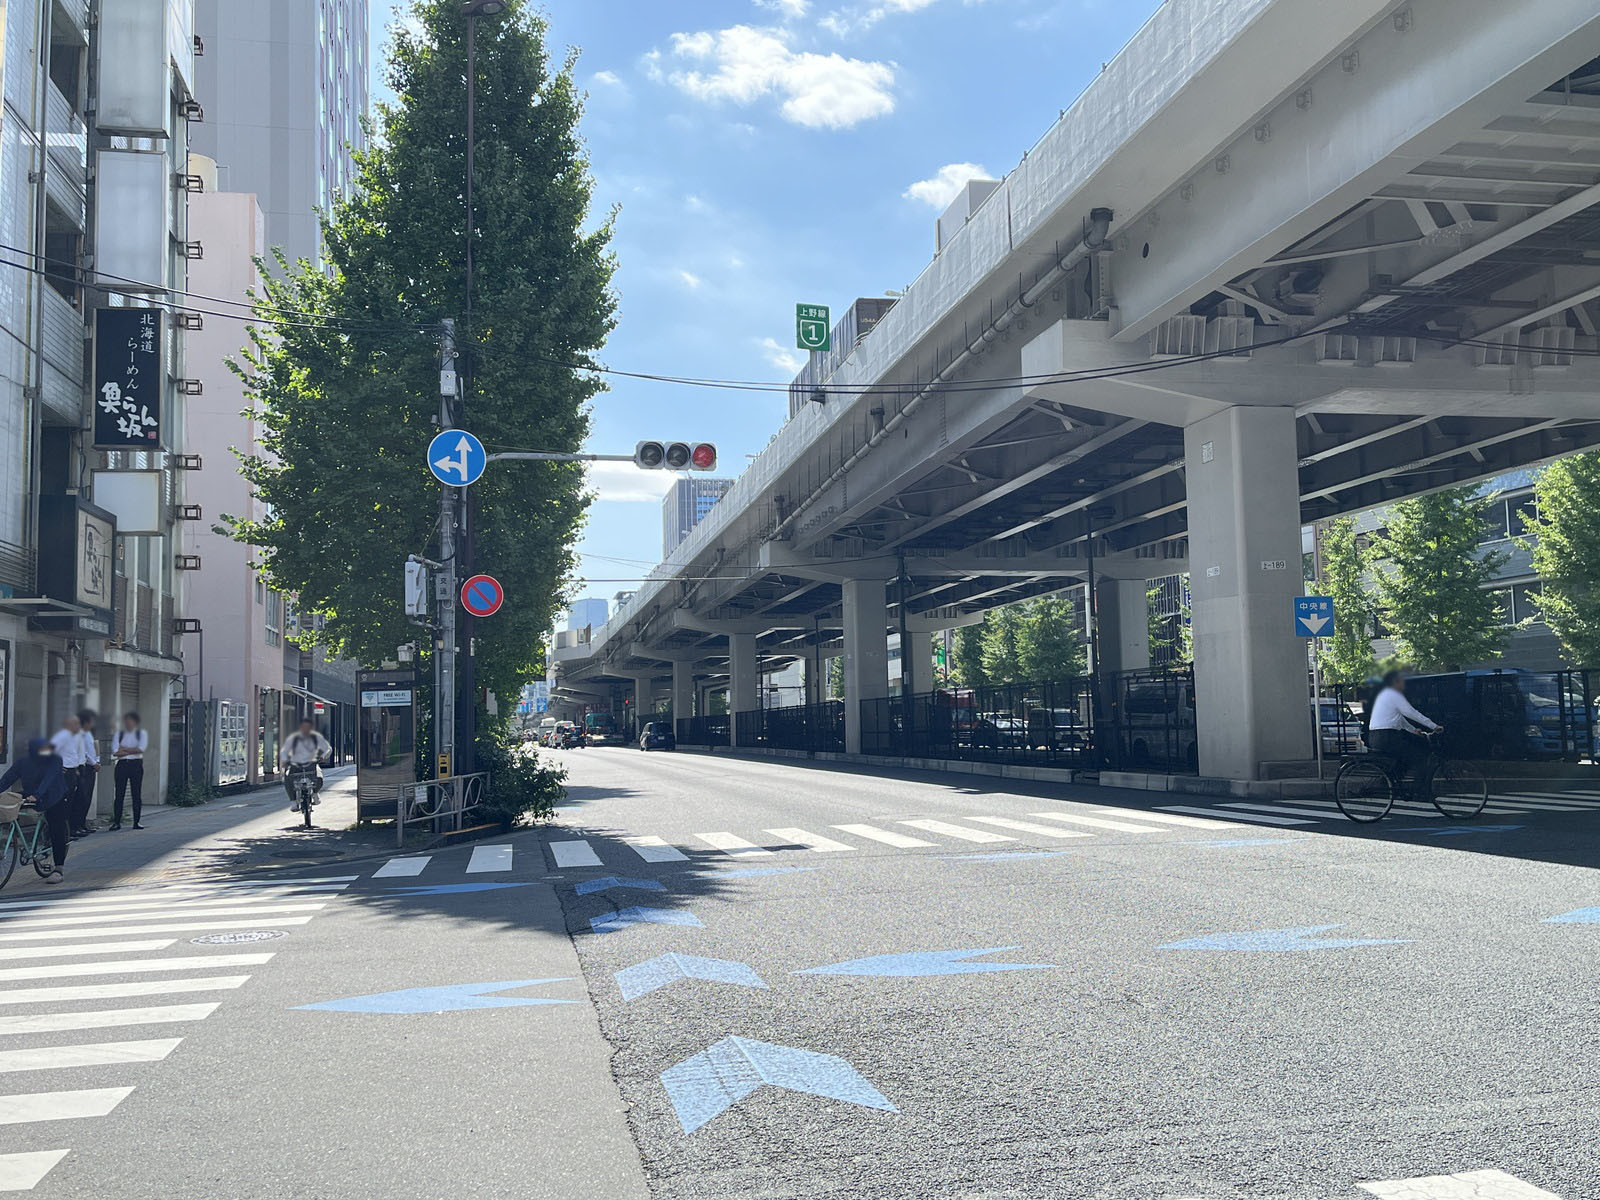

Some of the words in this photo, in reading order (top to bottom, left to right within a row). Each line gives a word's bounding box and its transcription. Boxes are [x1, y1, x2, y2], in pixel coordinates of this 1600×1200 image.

[800, 307, 827, 319] 上野線
[140, 313, 156, 353] 北海道
[808, 324, 819, 341] 1
[126, 337, 139, 390] らーめん
[1300, 601, 1328, 611] 中央線
